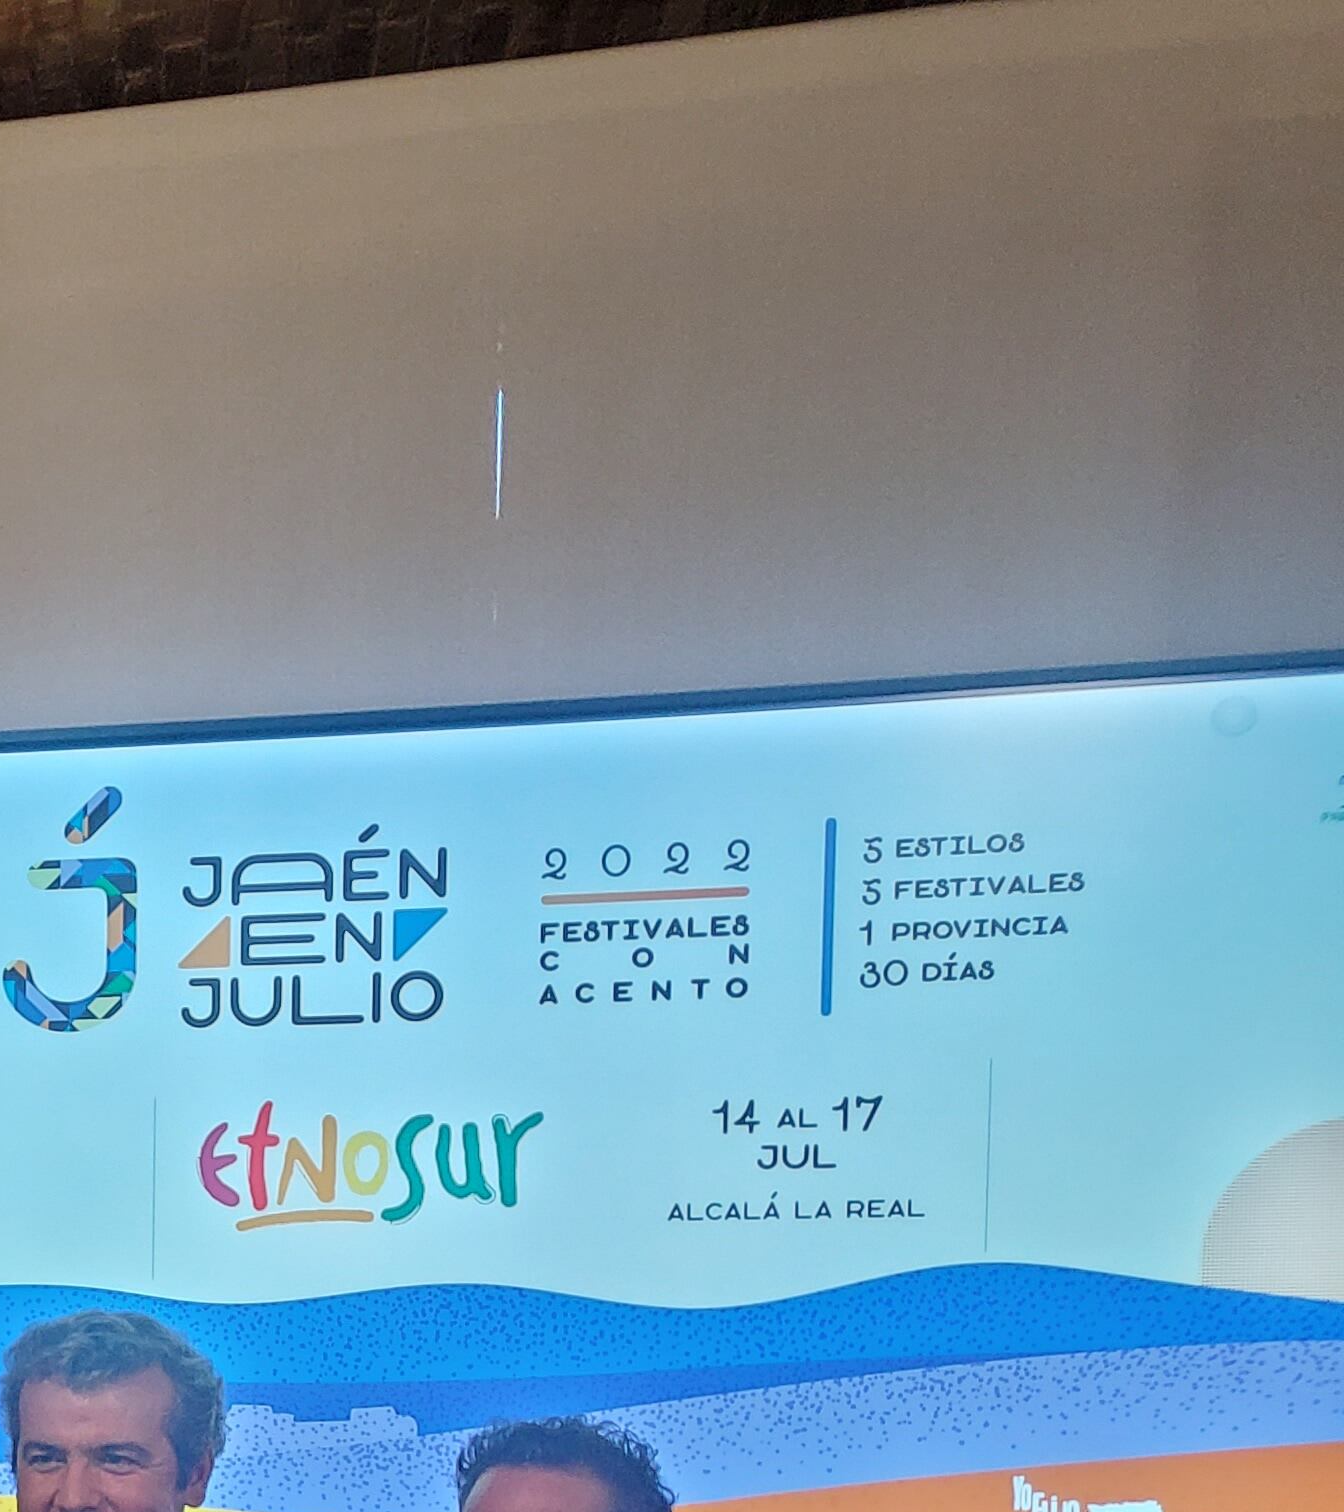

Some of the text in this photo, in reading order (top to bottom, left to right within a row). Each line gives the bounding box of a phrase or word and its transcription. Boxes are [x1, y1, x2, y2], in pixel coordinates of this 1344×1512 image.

[541, 839, 750, 880] 2022
[895, 833, 1025, 858] ESTILOS
[181, 823, 448, 908] JAÉN
[894, 872, 1085, 900] FESTIVALES
[240, 911, 383, 966] EN
[540, 914, 750, 944] FESTIVALES
[859, 915, 1068, 946] 1 PROVINCIA
[860, 951, 994, 989] 30 DÍAS
[180, 969, 445, 1029] JULIO
[539, 977, 749, 1005] ACENTO
[712, 1095, 883, 1134] 14 AL 17
[757, 1144, 837, 1170] JUL
[667, 1191, 925, 1221] ALCALÁ LA REAL
